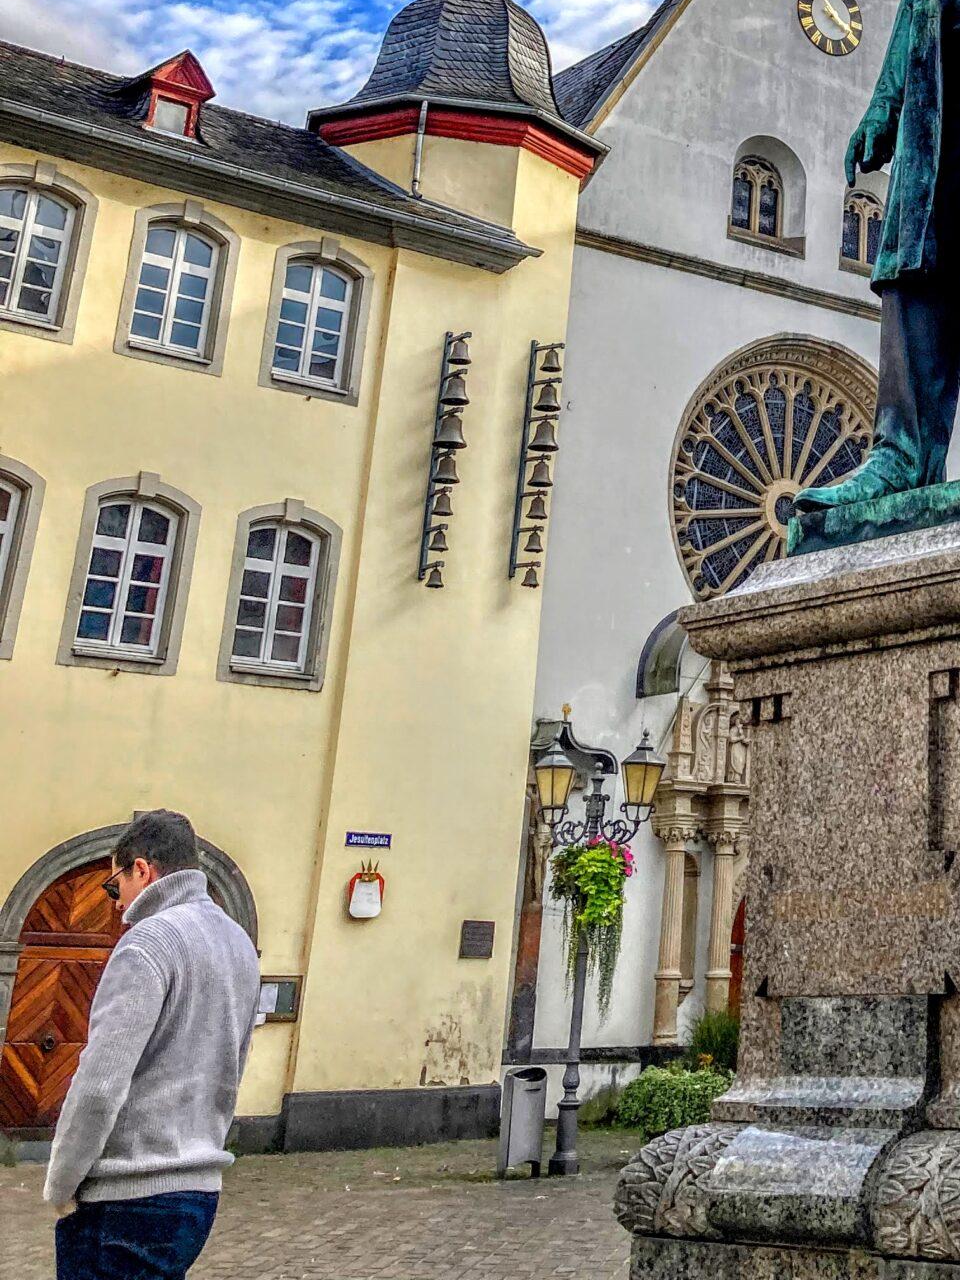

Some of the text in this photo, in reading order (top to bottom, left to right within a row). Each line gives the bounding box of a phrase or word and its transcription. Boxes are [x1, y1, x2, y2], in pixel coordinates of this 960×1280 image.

[799, 1, 811, 12] IX
[826, 39, 834, 54] VI
[840, 40, 848, 54] V
[349, 834, 389, 846] Jesuitenplatz
